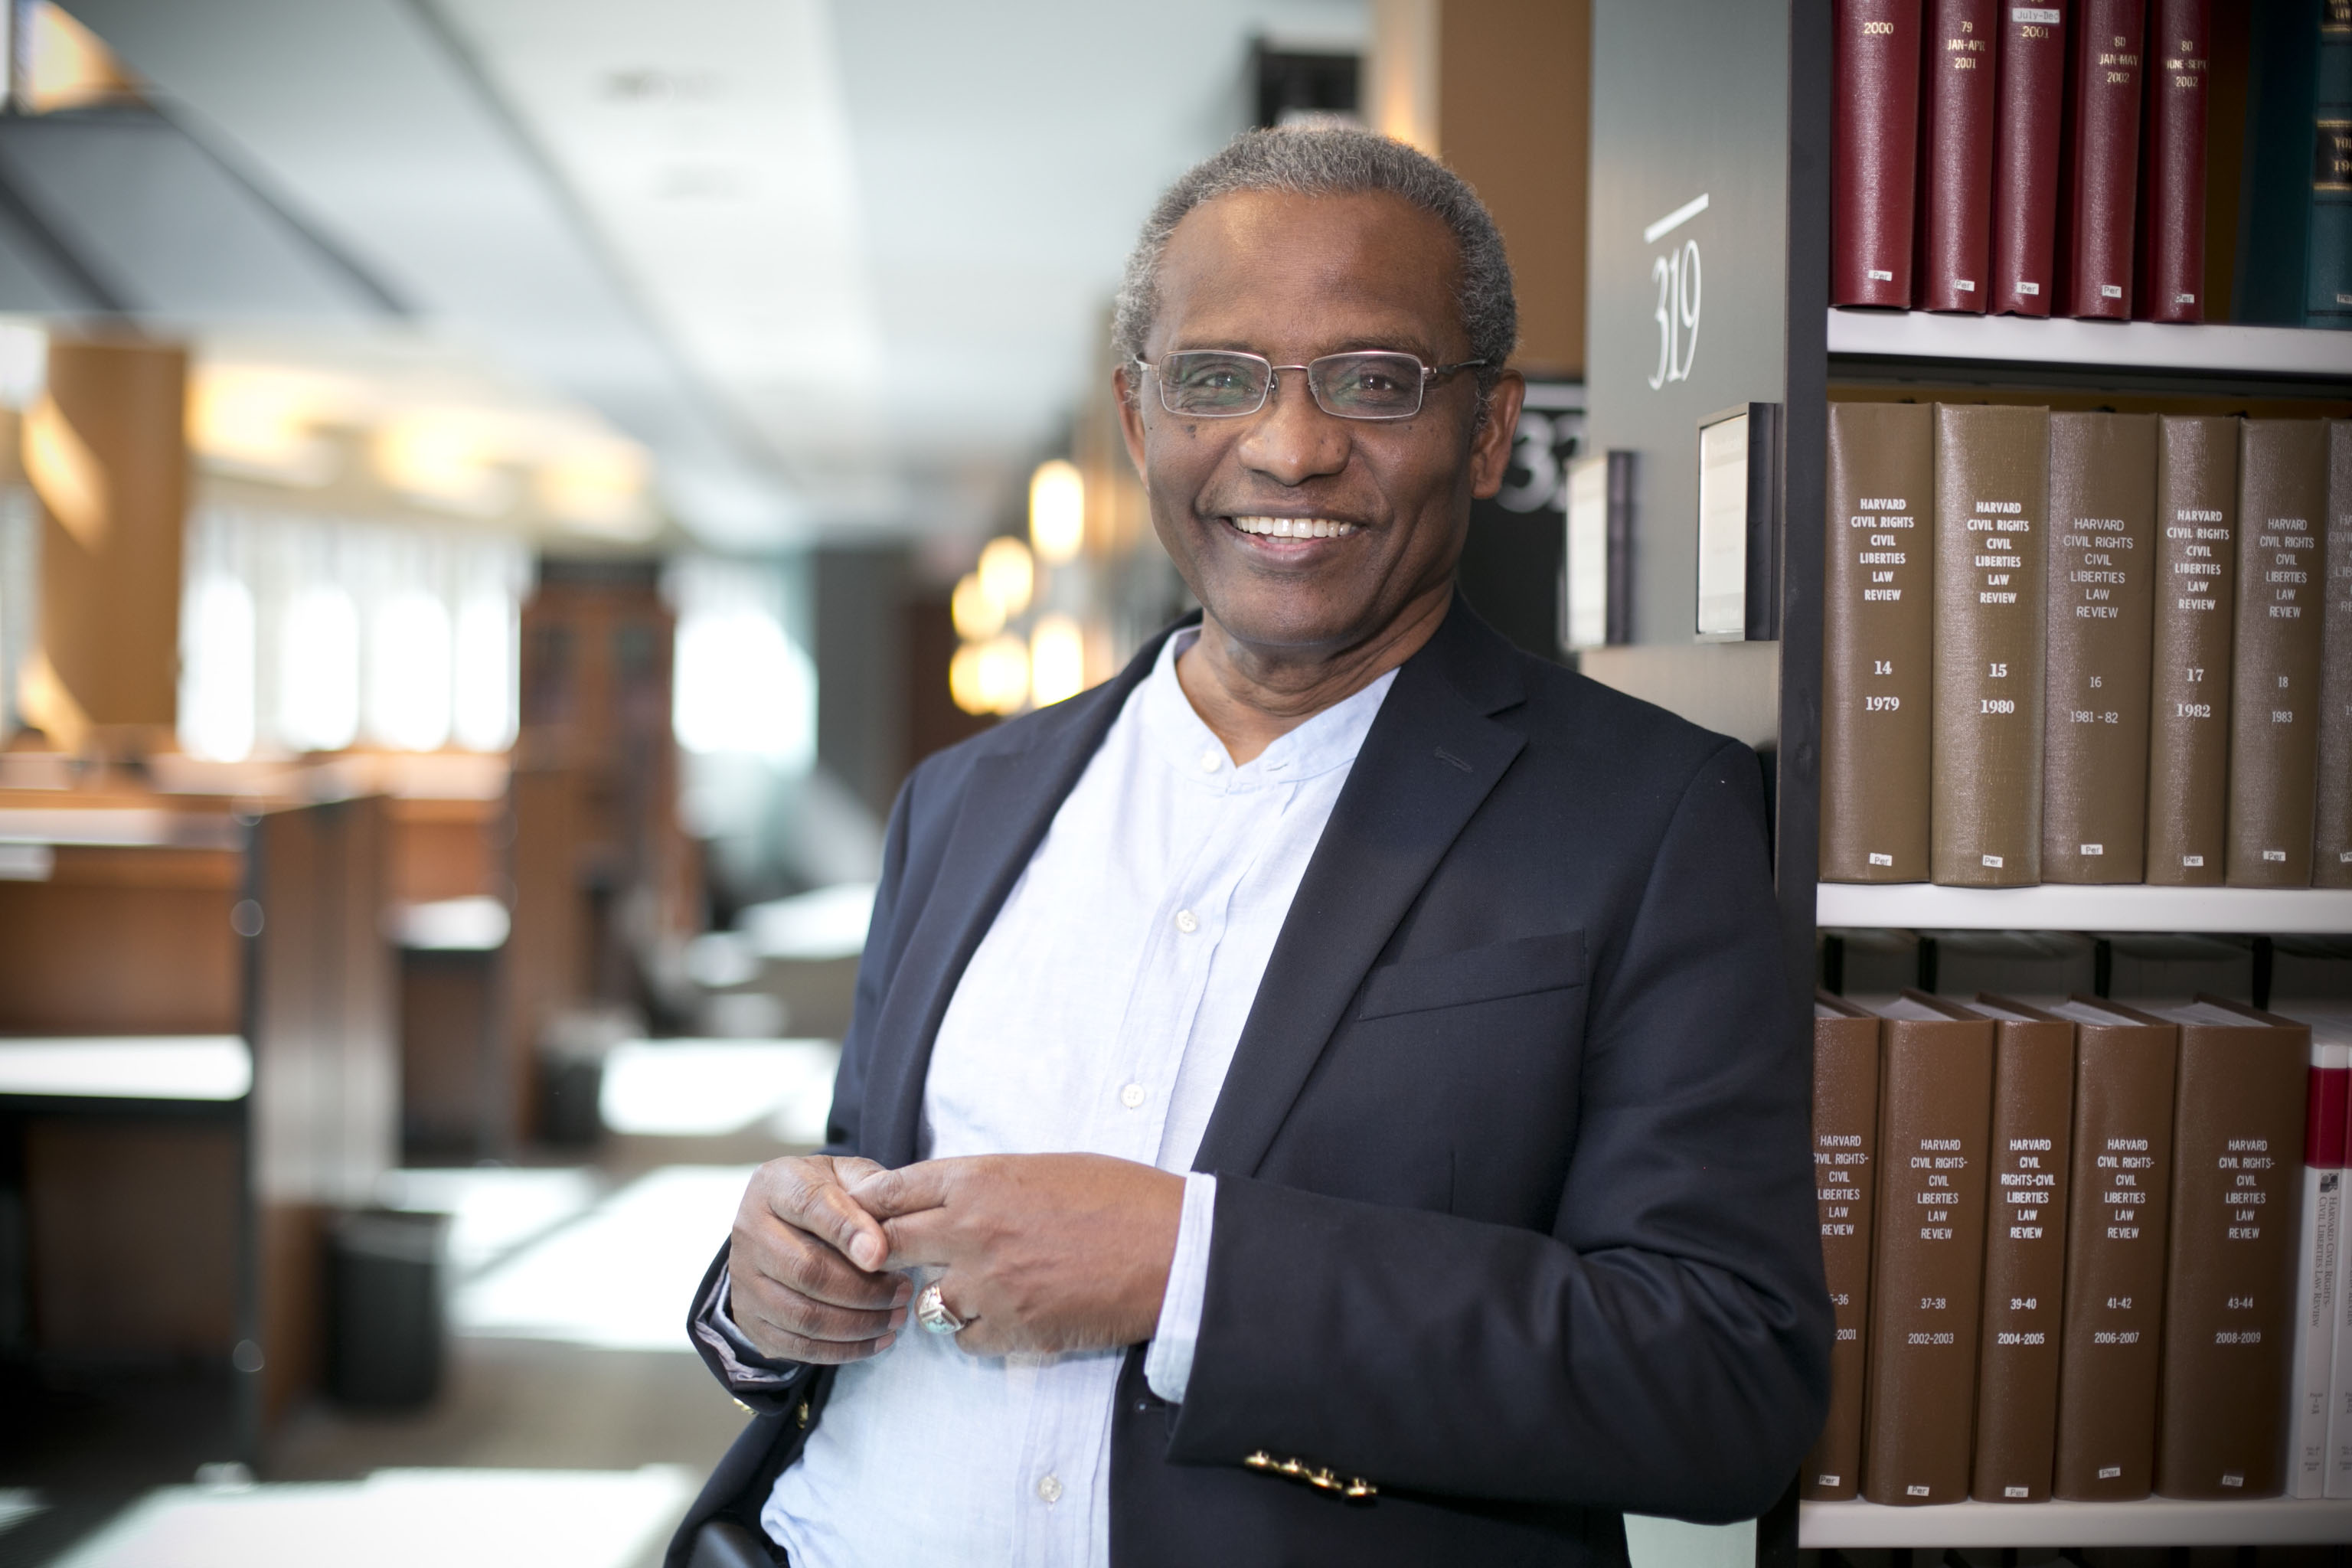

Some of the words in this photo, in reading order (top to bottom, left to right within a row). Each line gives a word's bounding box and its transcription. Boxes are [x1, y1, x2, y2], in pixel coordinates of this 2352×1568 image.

[1864, 21, 1893, 34] 2000
[1961, 21, 1973, 33] 79
[2021, 25, 2050, 38] 2001
[1947, 39, 1985, 51] JAN-APR
[2181, 40, 2194, 52] 80
[1955, 57, 1977, 69] 2001
[2106, 71, 2130, 83] 2002
[2175, 76, 2199, 87] 2002
[1873, 271, 1889, 280] Per
[1955, 280, 1971, 289] Per
[2020, 284, 2037, 293] Per
[2103, 286, 2120, 295] Per
[1648, 239, 1702, 391] 319
[1860, 498, 1906, 511] HARVARD
[1976, 501, 2021, 514] HARVARD
[2177, 510, 2223, 522] HARVARD
[1851, 517, 1877, 528] CIVIL
[1880, 517, 1914, 528] RIGHTS
[1967, 519, 1993, 531] CIVIL
[1997, 520, 2029, 531] RIGHTS
[2074, 518, 2124, 531] HARVARD
[2268, 518, 2307, 531] HARVARD
[2167, 527, 2193, 539] CIVIL
[2197, 528, 2230, 541] RIGHTS
[1870, 535, 1896, 546] CIVIL
[1986, 537, 2012, 550] CIVIL
[2063, 537, 2092, 548] CIVIL
[2096, 537, 2133, 549] RIGHTS
[2260, 537, 2282, 548] CIVIL
[2285, 537, 2314, 549] RIGHTS
[2186, 545, 2212, 557] CIVIL
[1860, 553, 1906, 564] LIBERTIES
[1975, 556, 2020, 567] LIBERTIES
[2085, 554, 2112, 566] CIVIL
[2276, 554, 2298, 565] CIVIL
[2175, 564, 2221, 575] LIBERTIES
[1873, 571, 1893, 583] LAW
[1988, 574, 2009, 586] LAW
[2070, 571, 2125, 583] LIBERTIES
[2265, 571, 2307, 583] LIBERTIES
[2187, 581, 2209, 593] LAW
[1864, 590, 1901, 601] REVIEW
[1980, 593, 2017, 604] REVIEW
[2086, 589, 2109, 601] LAW
[2276, 589, 2296, 600] LAW
[2178, 599, 2216, 611] REVIEW
[2076, 606, 2118, 619] REVIEW
[2269, 606, 2301, 618] REVIEW
[1874, 661, 1892, 675] 14
[1989, 663, 2007, 677] 15
[2187, 668, 2204, 682] 17
[2089, 676, 2102, 688] 16
[2278, 676, 2289, 688] 18
[1866, 697, 1900, 710] 1979
[1980, 700, 2014, 714] 1980
[2069, 710, 2095, 723] 1981
[2176, 704, 2211, 718] 1982
[2272, 711, 2293, 723] 1983
[2086, 846, 2101, 854] Per
[1874, 856, 1890, 865] Per
[1984, 856, 2001, 865] Per
[2185, 856, 2200, 864] Per
[1820, 1135, 1861, 1147] HARVARD
[1921, 1139, 1961, 1151] HARVARD
[2010, 1139, 2052, 1151] HARVARD
[2107, 1139, 2148, 1151] HARVARD
[2228, 1140, 2268, 1152] HARVARD
[1835, 1153, 1869, 1165] RIGHTS-
[1911, 1157, 1932, 1168] CIVIL
[1936, 1158, 1968, 1169] RIGHTS-
[2019, 1157, 2040, 1169] CIVIL
[2097, 1156, 2119, 1168] CIVIL
[2122, 1157, 2154, 1168] RIGHTS-
[2219, 1157, 2239, 1168] CIVIL
[2243, 1158, 2275, 1169] RIGHTS-
[1828, 1171, 1850, 1183] CIVIL
[1929, 1175, 1949, 1187] CIVIL
[2001, 1174, 2056, 1186] RIGHTS-CIVIL
[2115, 1174, 2137, 1186] CIVIL
[2236, 1175, 2257, 1186] CIVIL
[1818, 1189, 1860, 1200] LIBERTIES
[1917, 1193, 1958, 1204] LIBERTIES
[2007, 1191, 2049, 1204] LIBERTIES
[2104, 1192, 2145, 1204] LIBERTIES
[2226, 1192, 2266, 1204] LIBERTIES
[1828, 1207, 1848, 1218] LAW
[2318, 1196, 2328, 1221] CIVIL
[1928, 1210, 1948, 1222] LAW
[2017, 1210, 2038, 1221] LAW
[2115, 1210, 2135, 1221] LAW
[2236, 1210, 2255, 1221] LAW
[2328, 1197, 2337, 1240] HARVARD
[1821, 1224, 1854, 1236] REVIEW
[1920, 1228, 1953, 1240] REVIEW
[2010, 1227, 2043, 1239] REVIEW
[2107, 1227, 2139, 1239] REVIEW
[2229, 1227, 2260, 1240] REVIEW
[2315, 1225, 2326, 1268] LIBERTIES
[2325, 1243, 2334, 1266] CIVIL
[2314, 1271, 2323, 1290] LAW
[1920, 1298, 1946, 1310] 37-38
[2011, 1298, 2037, 1310] 39-40
[2107, 1298, 2132, 1309] 41-42
[2227, 1298, 2253, 1309] 43-44
[2312, 1293, 2321, 1328] REVIEW
[1908, 1333, 1954, 1344] 2002-2003
[1998, 1333, 2045, 1345] 2004-2005
[2094, 1331, 2140, 1344] 2006-2007
[2216, 1332, 2262, 1344] 2008-2009
[2102, 1468, 2118, 1478] Per
[1821, 1475, 1836, 1485] Per
[2225, 1476, 2241, 1485] Per
[1912, 1486, 1927, 1494] Per
[2010, 1488, 2025, 1498] Per
